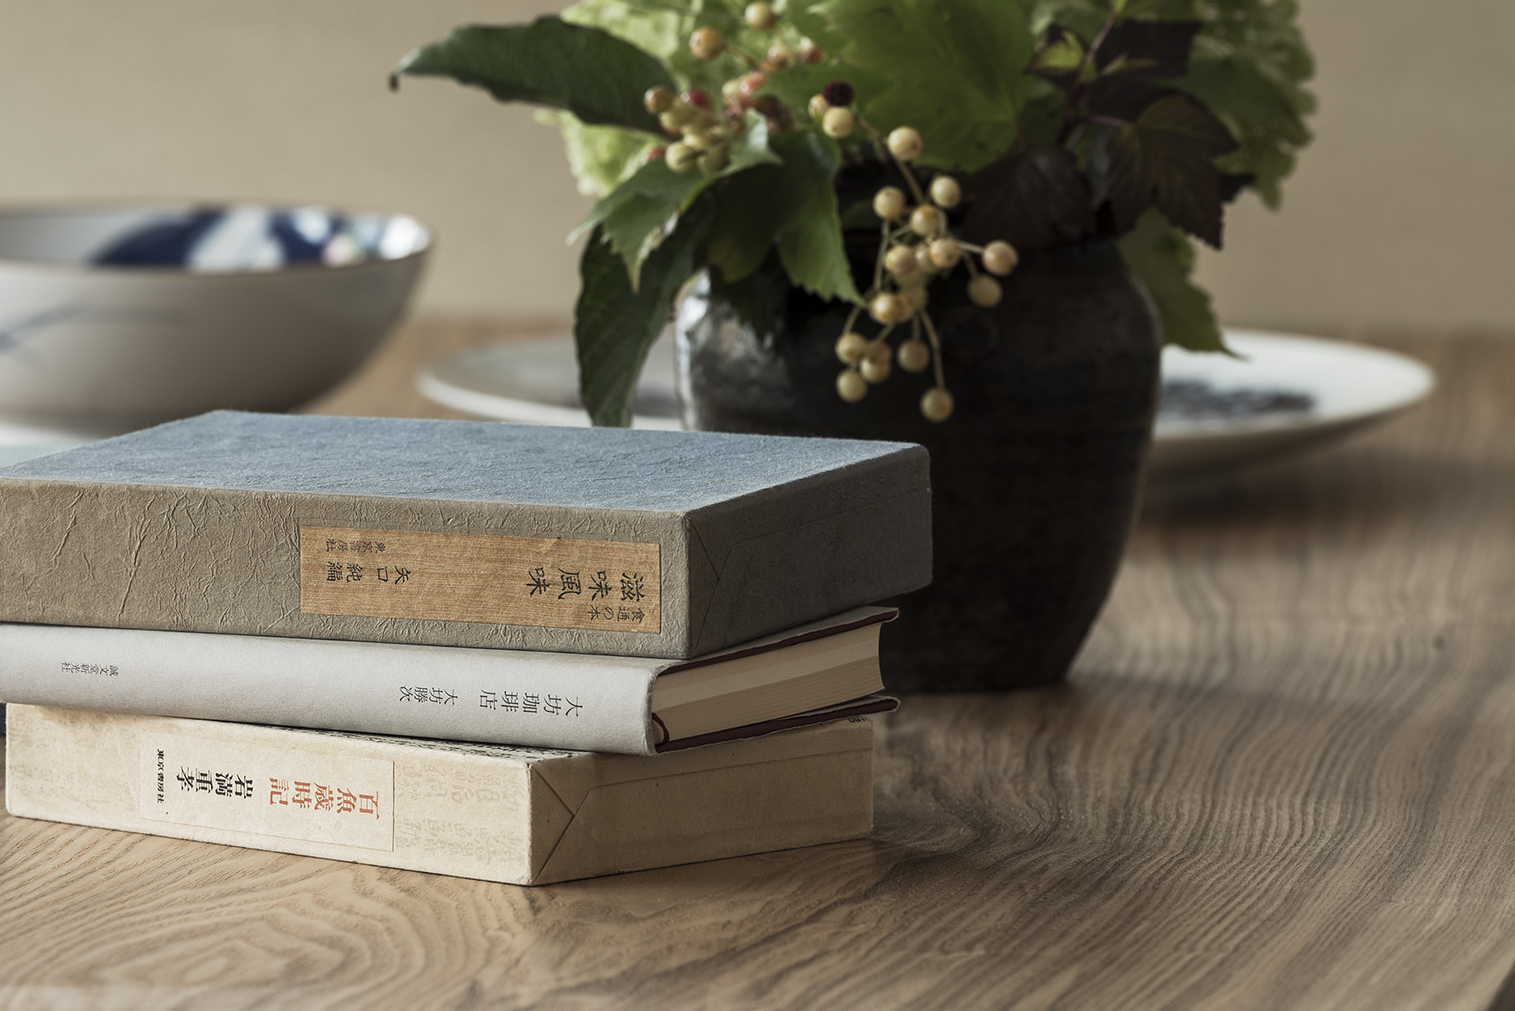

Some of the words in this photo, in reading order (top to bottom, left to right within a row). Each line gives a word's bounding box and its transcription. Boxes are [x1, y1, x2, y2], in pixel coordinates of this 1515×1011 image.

[525, 566, 646, 604] 滋味風味
[587, 604, 646, 624] 食通の本
[60, 661, 120, 677] 誠文堂新光社
[398, 685, 459, 706] 大坊勝次
[478, 688, 584, 718] 大坊珈琲店
[175, 765, 255, 800] 岩満重孝
[268, 777, 381, 821] 百魚歳時記
